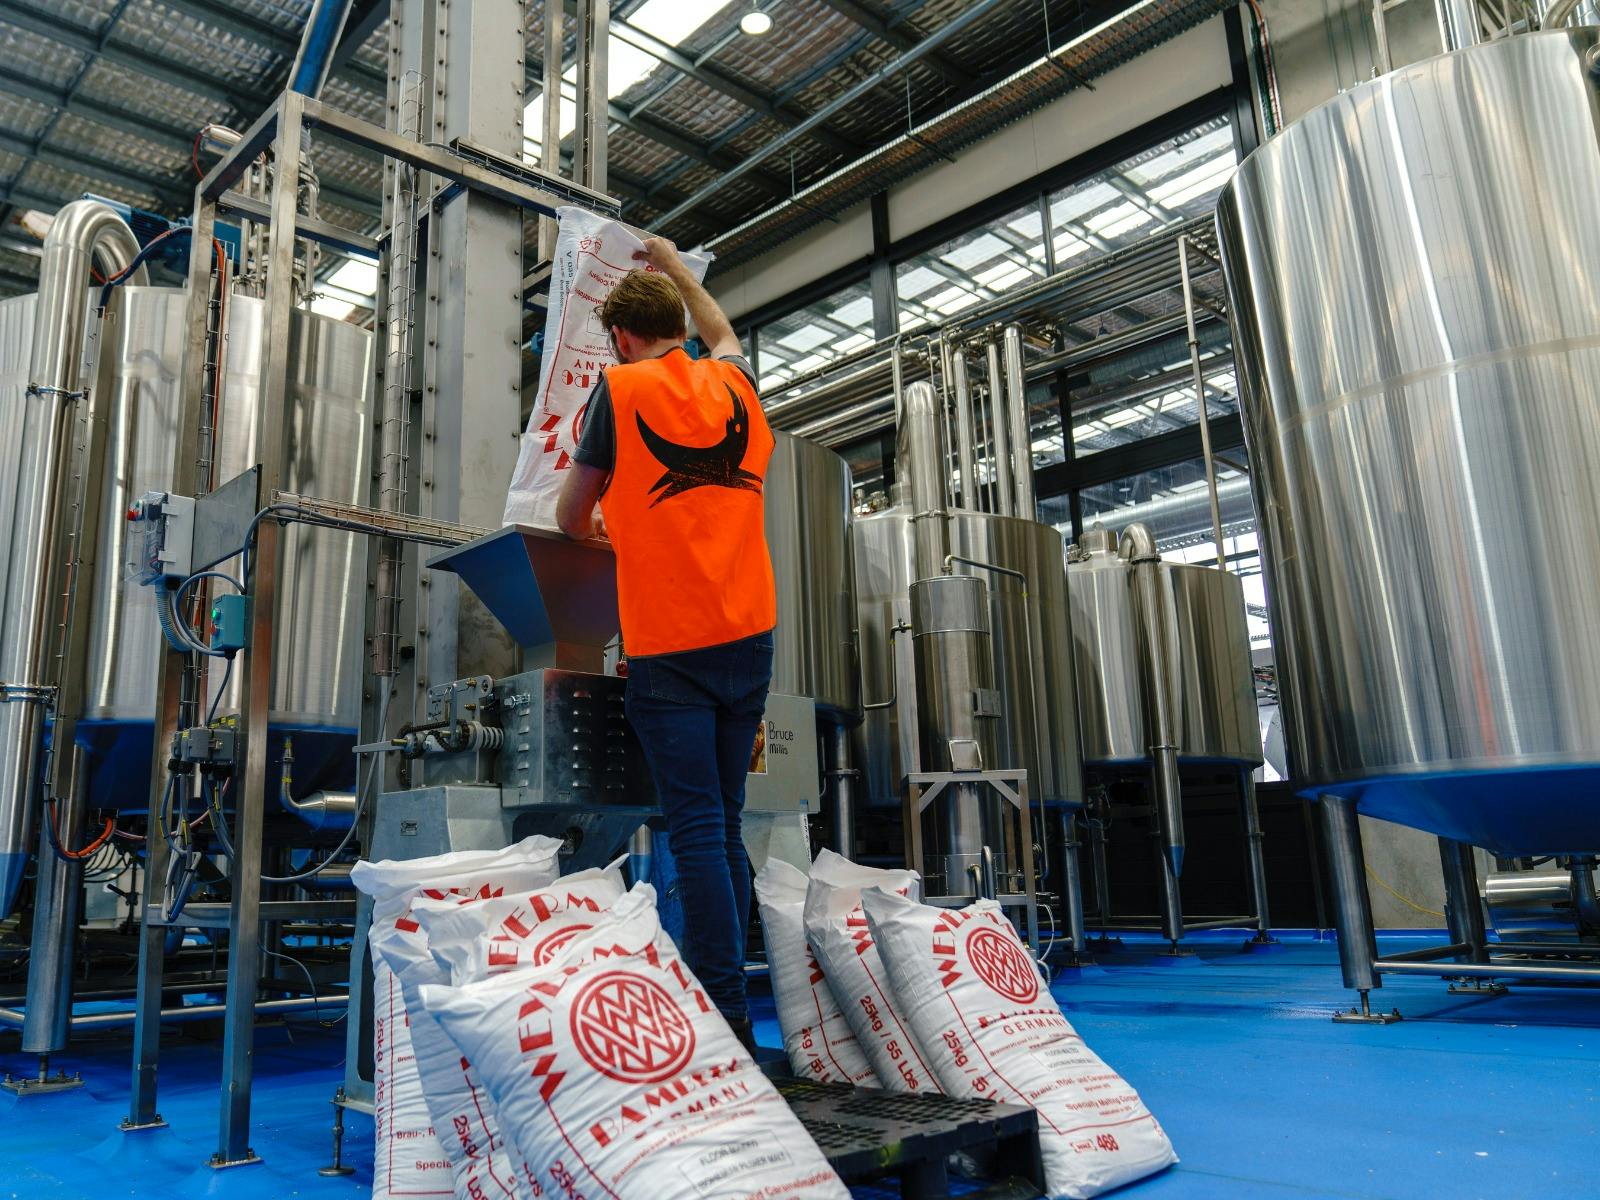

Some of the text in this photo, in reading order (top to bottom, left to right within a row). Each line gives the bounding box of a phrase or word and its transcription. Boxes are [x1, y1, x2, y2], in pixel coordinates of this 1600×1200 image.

[769, 721, 793, 740] Bruce
[376, 1018, 384, 1061] 25kg
[860, 995, 884, 1032] 25kg
[886, 1040, 903, 1060] 55
[898, 1060, 919, 1090] Lbs
[942, 1030, 968, 1067] 25kg
[1096, 1134, 1119, 1152] 468
[416, 1160, 453, 1171] Specia
